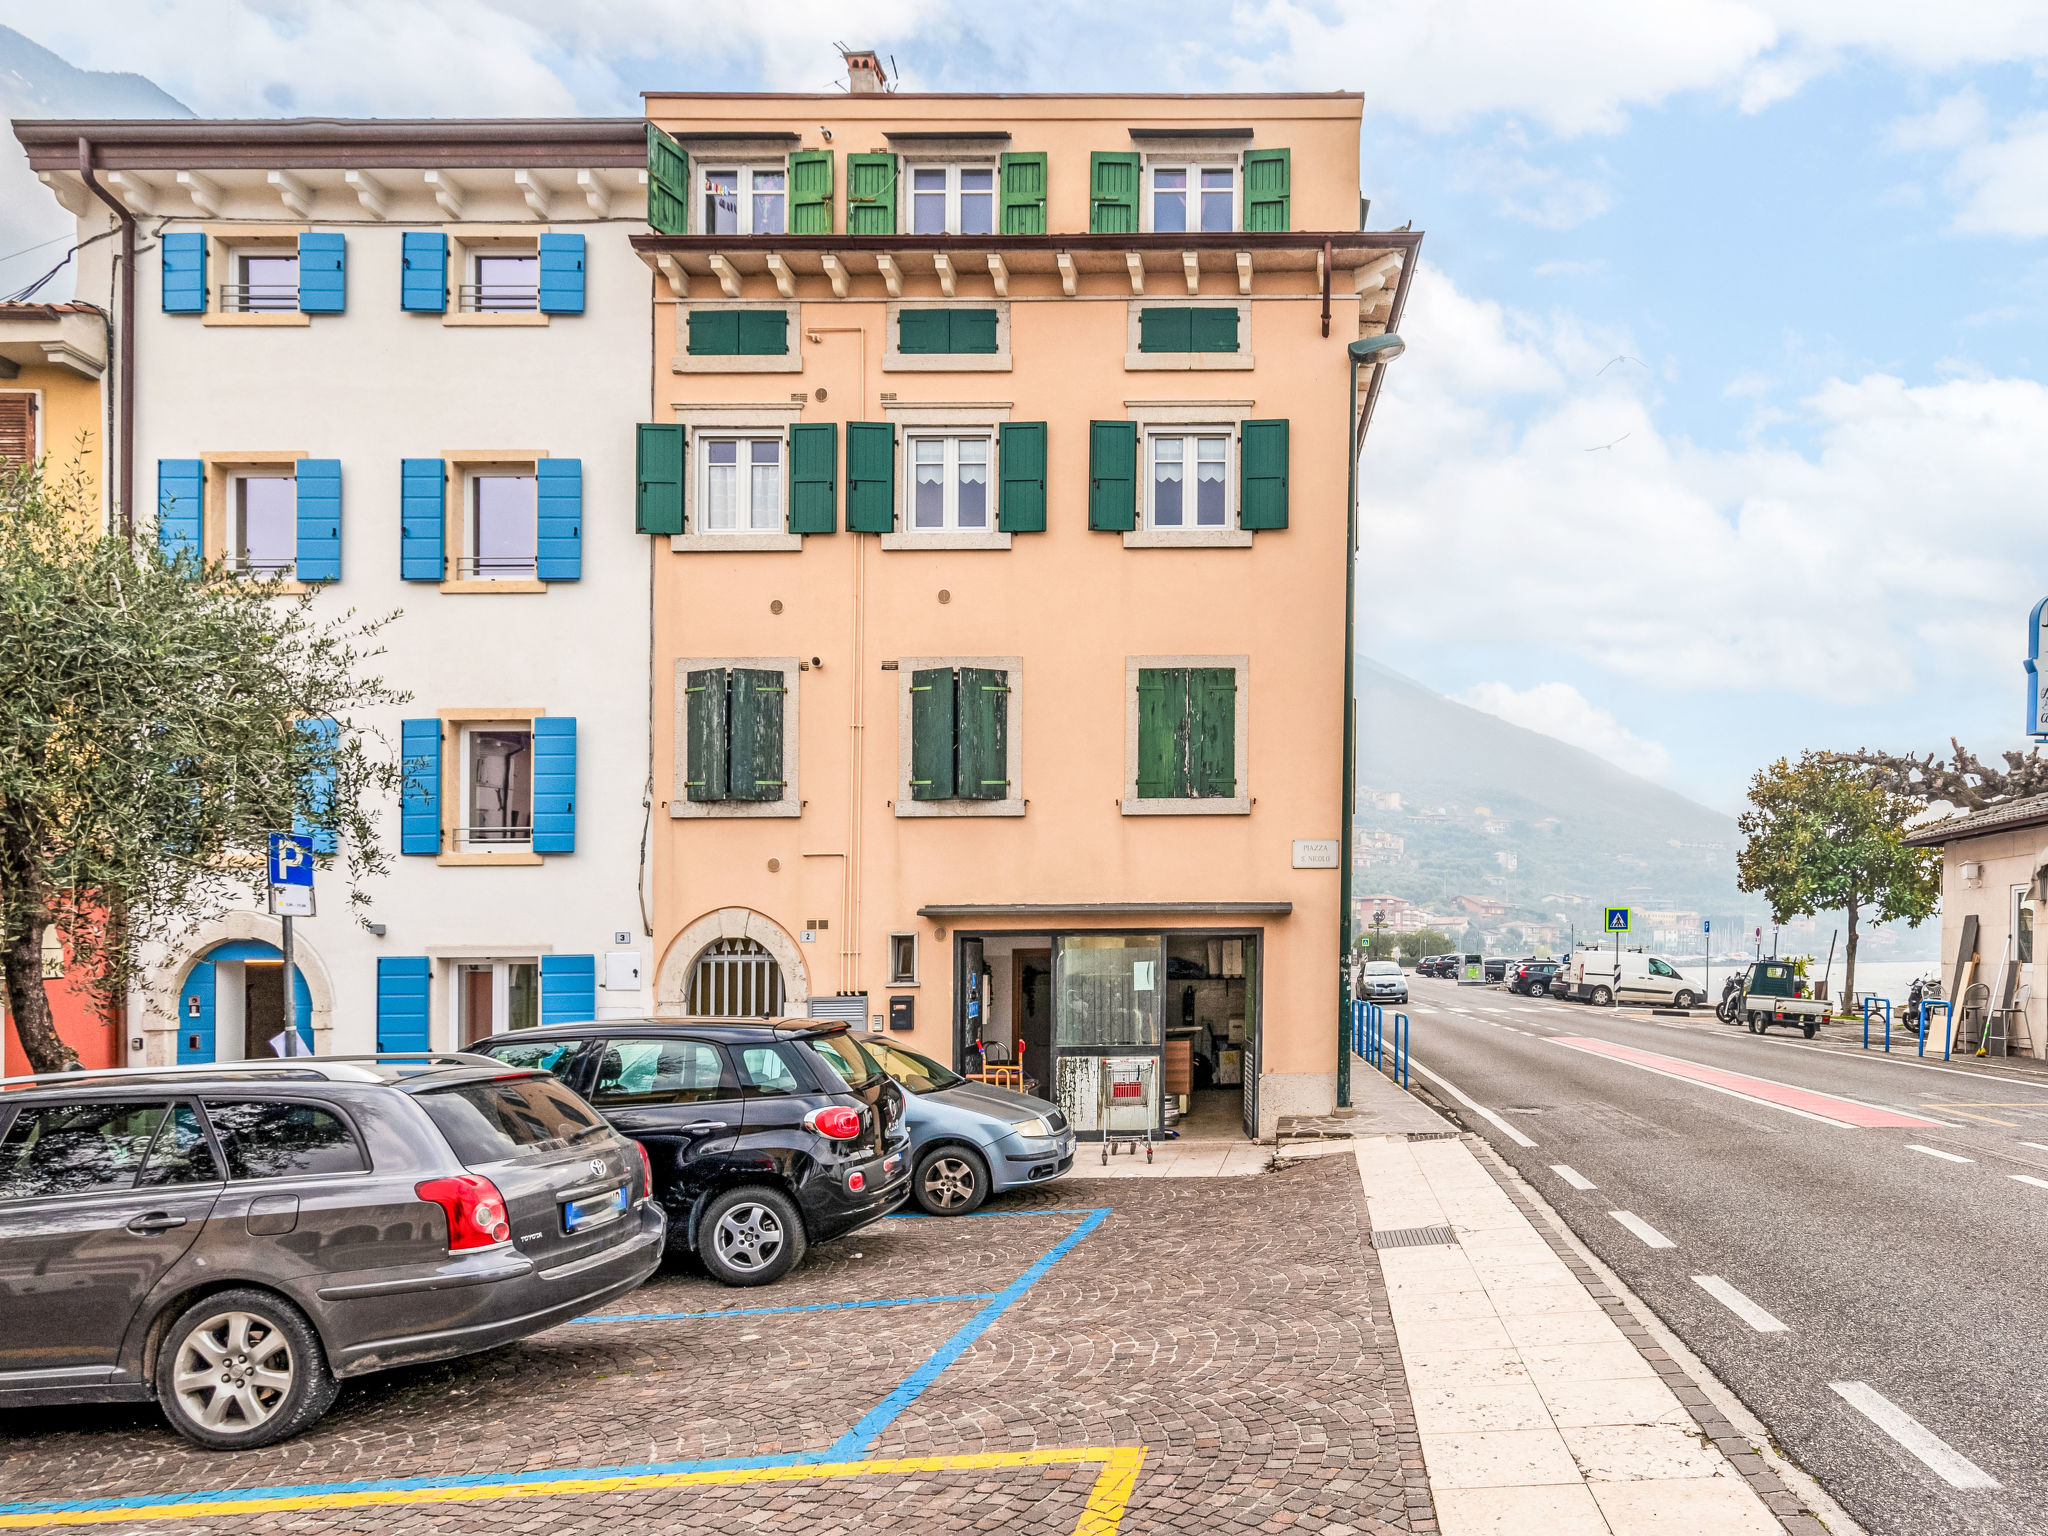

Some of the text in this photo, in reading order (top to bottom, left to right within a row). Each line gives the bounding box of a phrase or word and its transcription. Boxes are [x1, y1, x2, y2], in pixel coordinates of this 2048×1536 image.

[279, 839, 303, 880] P
[619, 934, 626, 942] 3
[520, 1231, 543, 1243] TOYOTA
